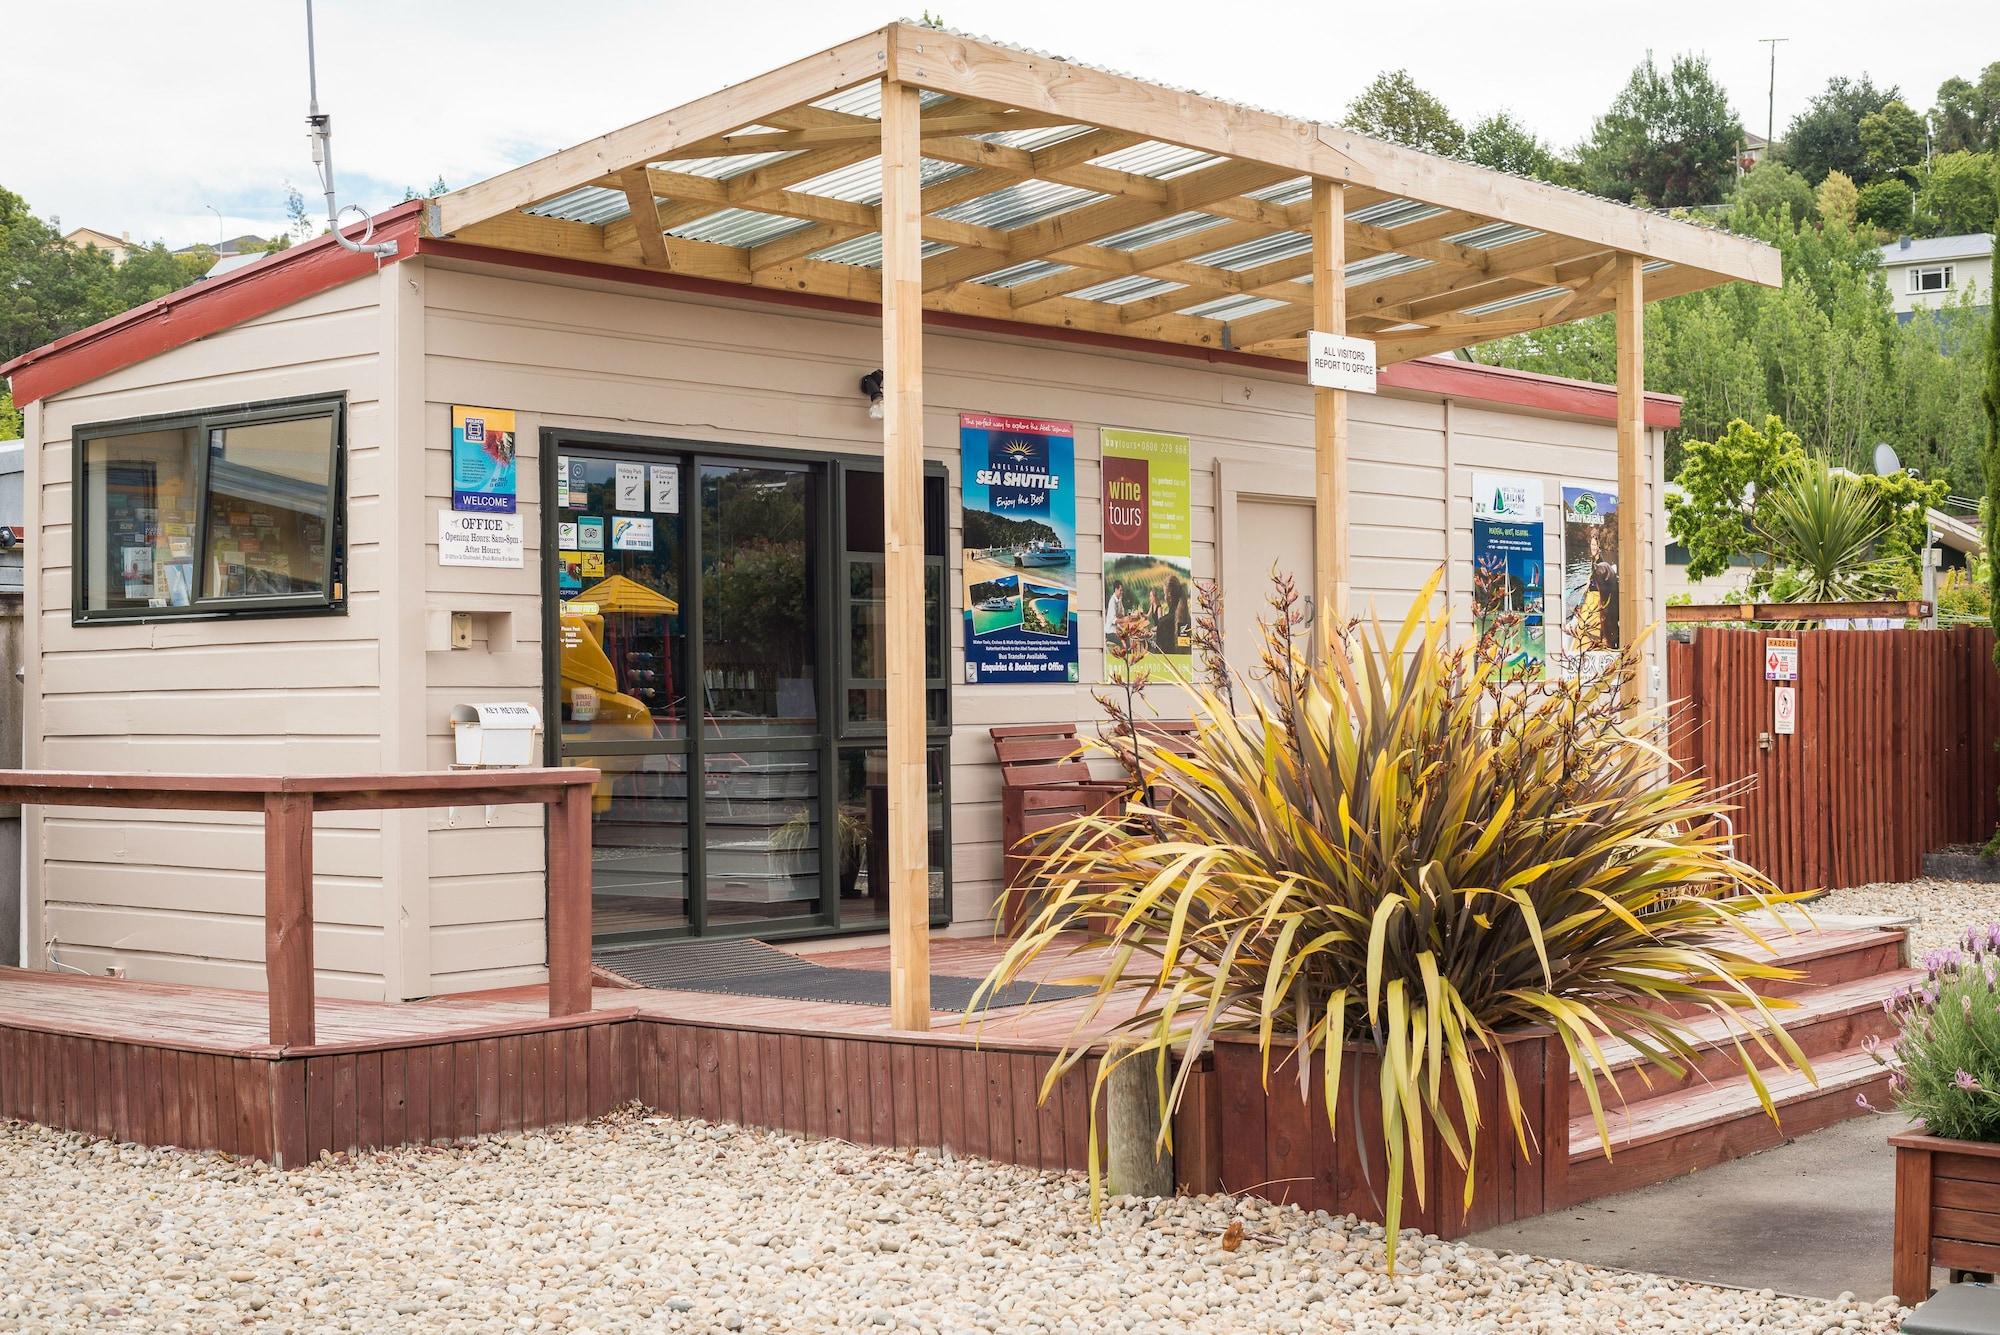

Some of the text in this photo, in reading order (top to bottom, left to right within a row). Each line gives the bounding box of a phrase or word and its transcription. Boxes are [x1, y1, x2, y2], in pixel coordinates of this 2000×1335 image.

[1324, 347, 1365, 361] ALL VISITORS
[1315, 359, 1373, 375] REPORT TO OFFICE
[976, 418, 991, 427] perfect
[1005, 420, 1011, 428] to
[1012, 422, 1029, 431] explore
[1030, 422, 1038, 430] the
[976, 470, 1058, 489] SEA SHUTTLE
[1109, 476, 1141, 501] wine
[462, 496, 508, 507] WELCOME
[996, 492, 1044, 509] Enjoy the Best
[1109, 502, 1141, 526] tours
[1566, 510, 1604, 527] kahu kayaks
[462, 518, 502, 530] OFFICE
[446, 532, 469, 542] Opening
[471, 533, 490, 542] Hours:
[982, 662, 1007, 673] Enquiries
[1009, 662, 1013, 671] &
[1015, 662, 1039, 673] Bookings
[1048, 662, 1064, 671] Office
